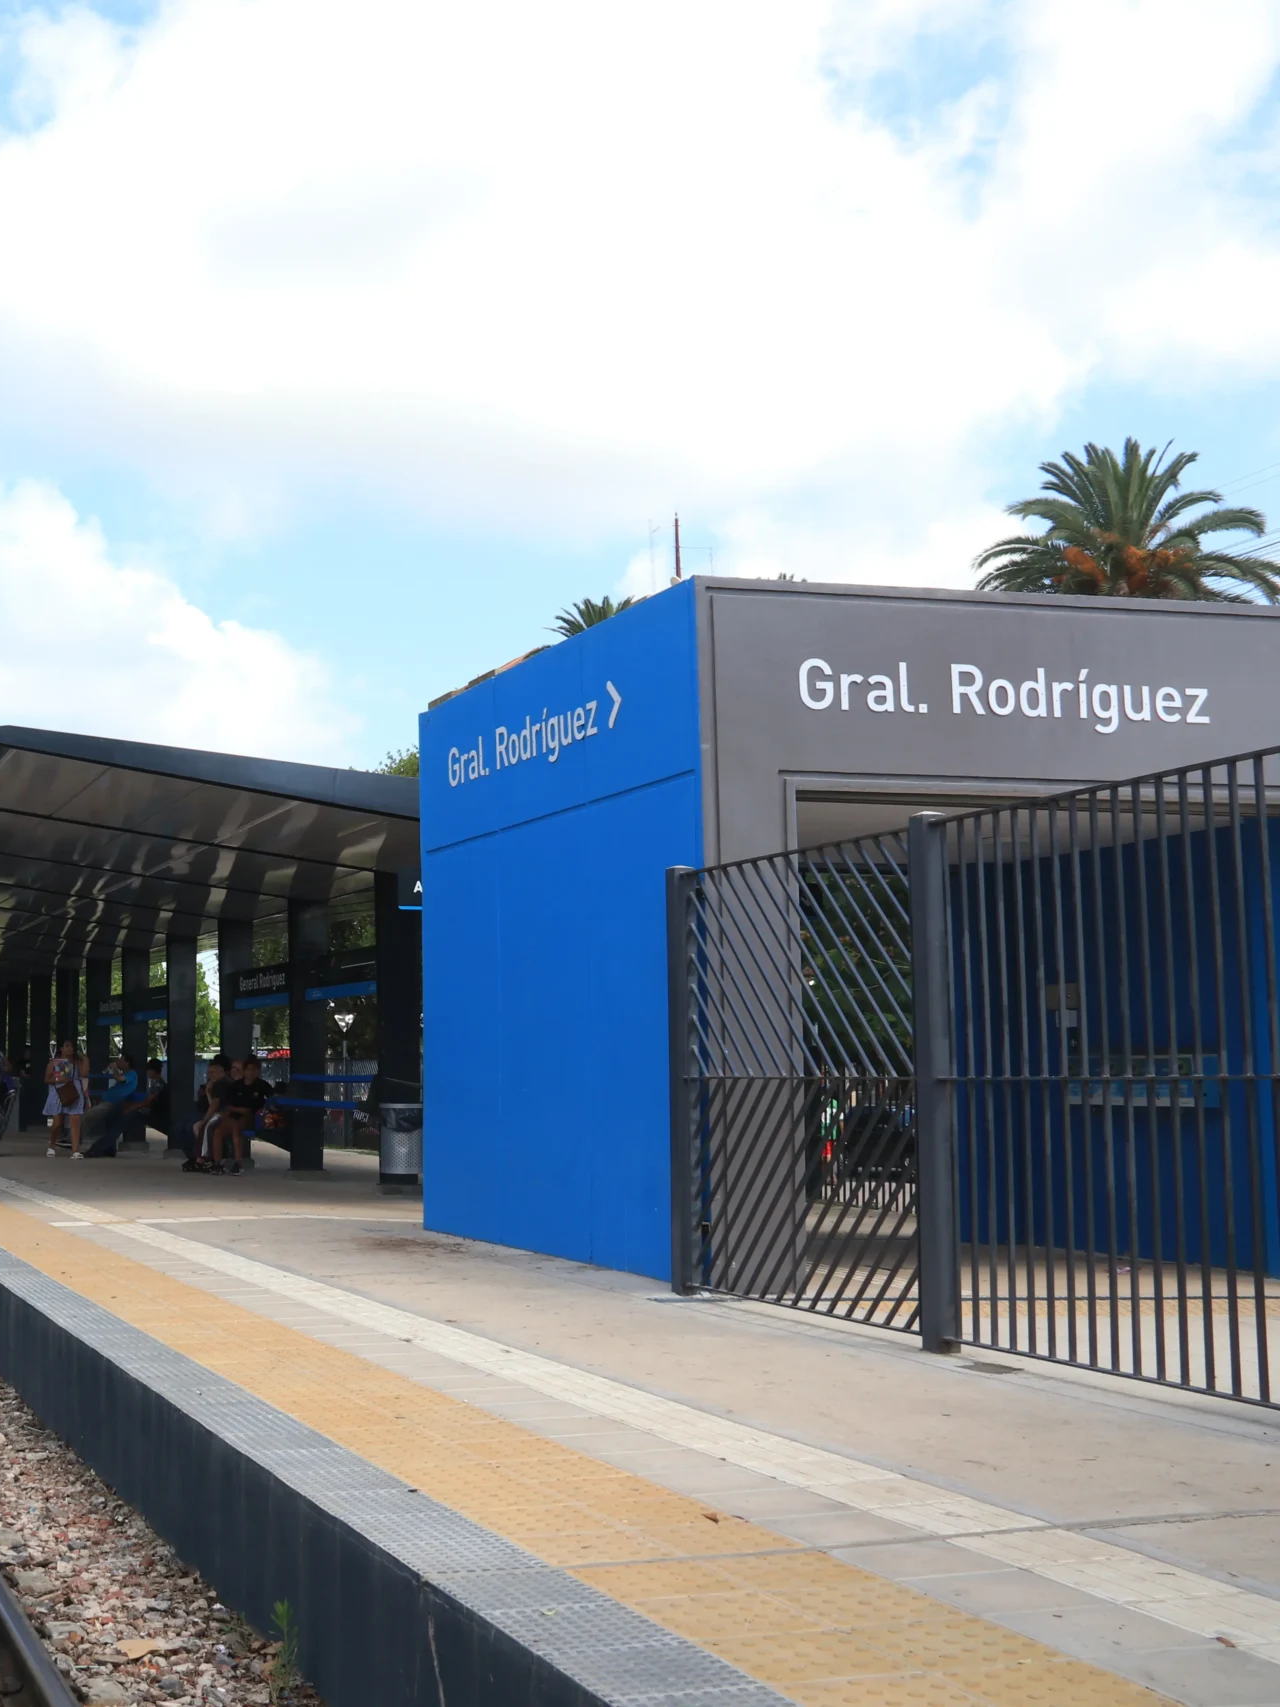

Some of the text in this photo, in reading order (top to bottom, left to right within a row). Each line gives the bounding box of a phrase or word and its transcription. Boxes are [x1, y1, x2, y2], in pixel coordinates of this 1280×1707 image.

[798, 657, 1211, 734] Gral. Rodríguez
[448, 699, 598, 788] Gral. Rodríguez
[239, 968, 286, 992] General Rodríguez
